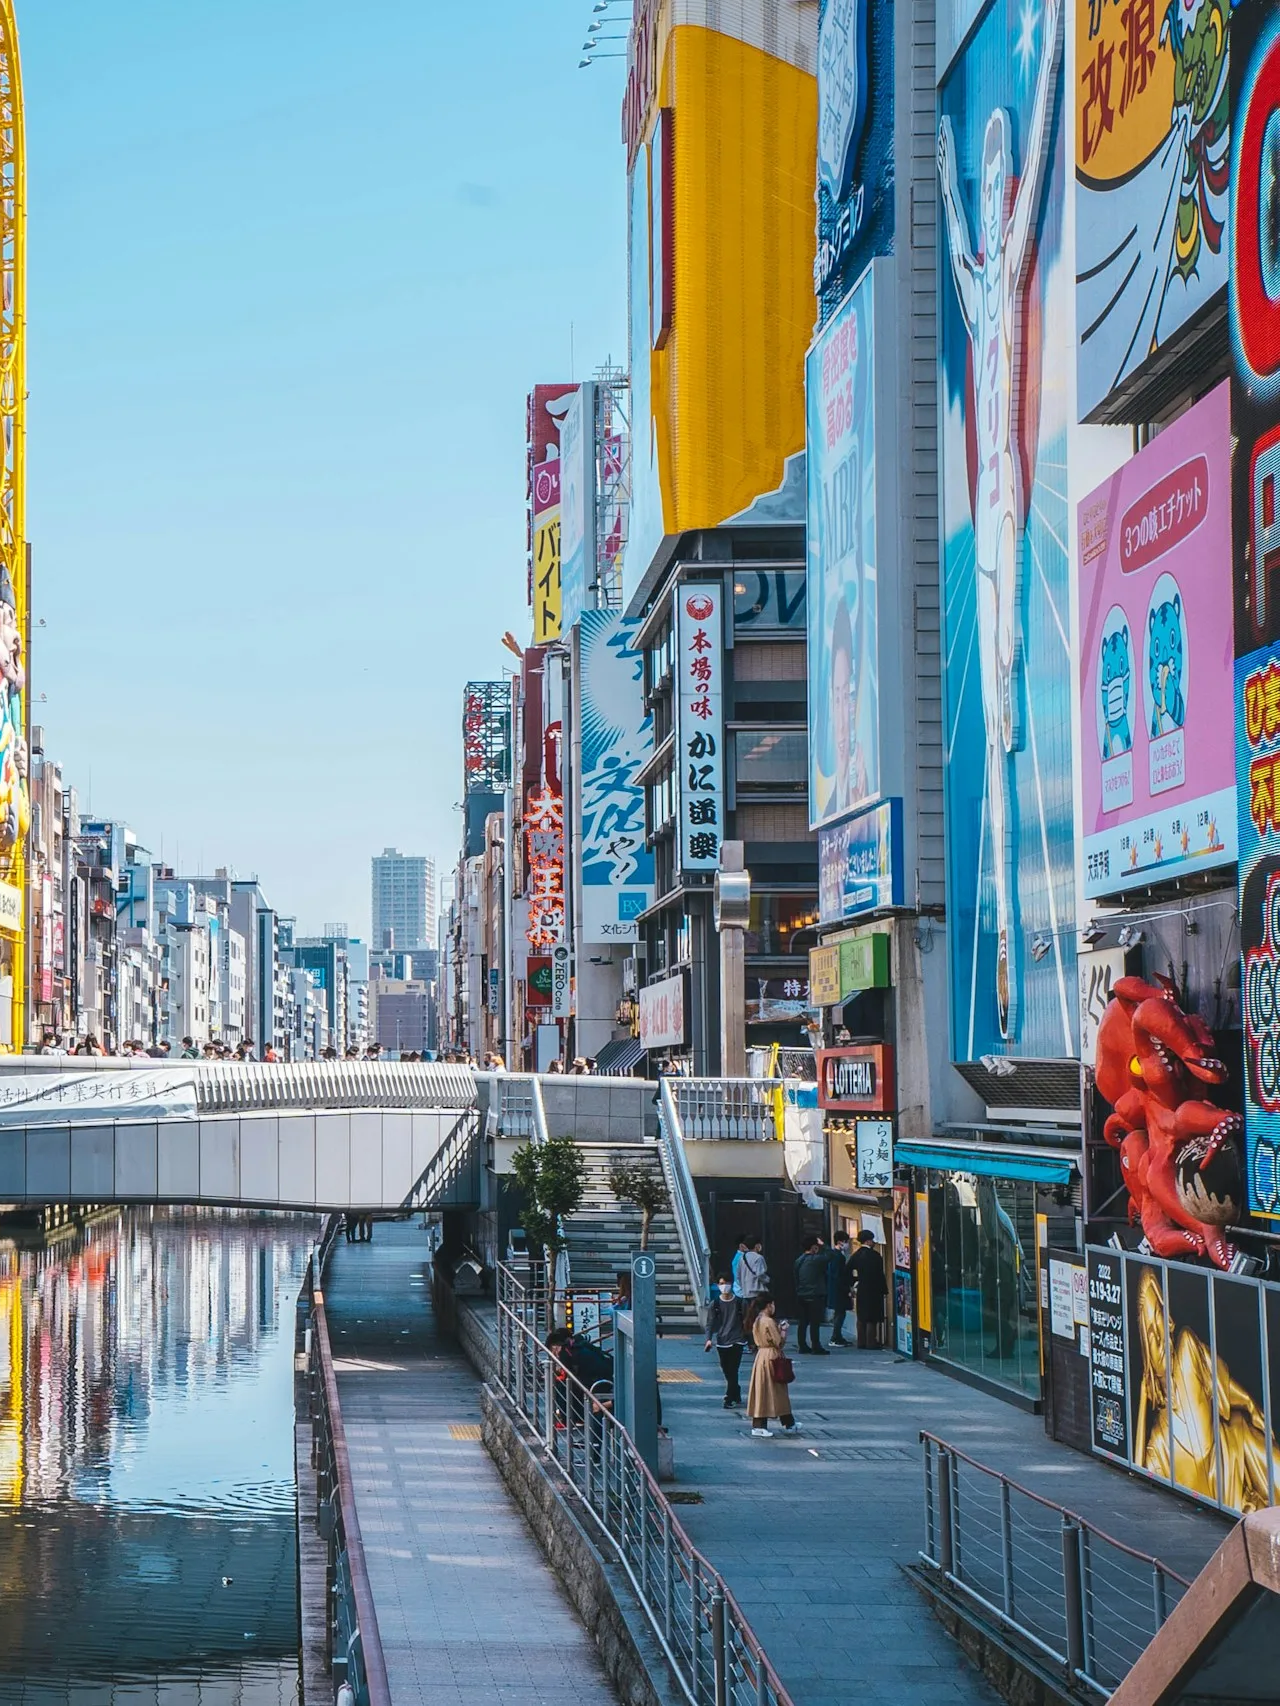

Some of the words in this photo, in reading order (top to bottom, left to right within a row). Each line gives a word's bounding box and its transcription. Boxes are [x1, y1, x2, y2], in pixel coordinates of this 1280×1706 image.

[986, 322, 1001, 510] グリコ
[824, 448, 858, 573] MBP
[538, 521, 560, 637] バイト
[688, 627, 714, 720] 本場の味
[526, 788, 565, 945] 大阪王将
[623, 899, 642, 913] BX
[555, 962, 565, 989] ZERO
[555, 990, 563, 1010] cafe
[834, 1062, 872, 1095] LOTTERIA
[1097, 1264, 1112, 1280] 2022
[1090, 1279, 1121, 1305] 3.19-3.27
